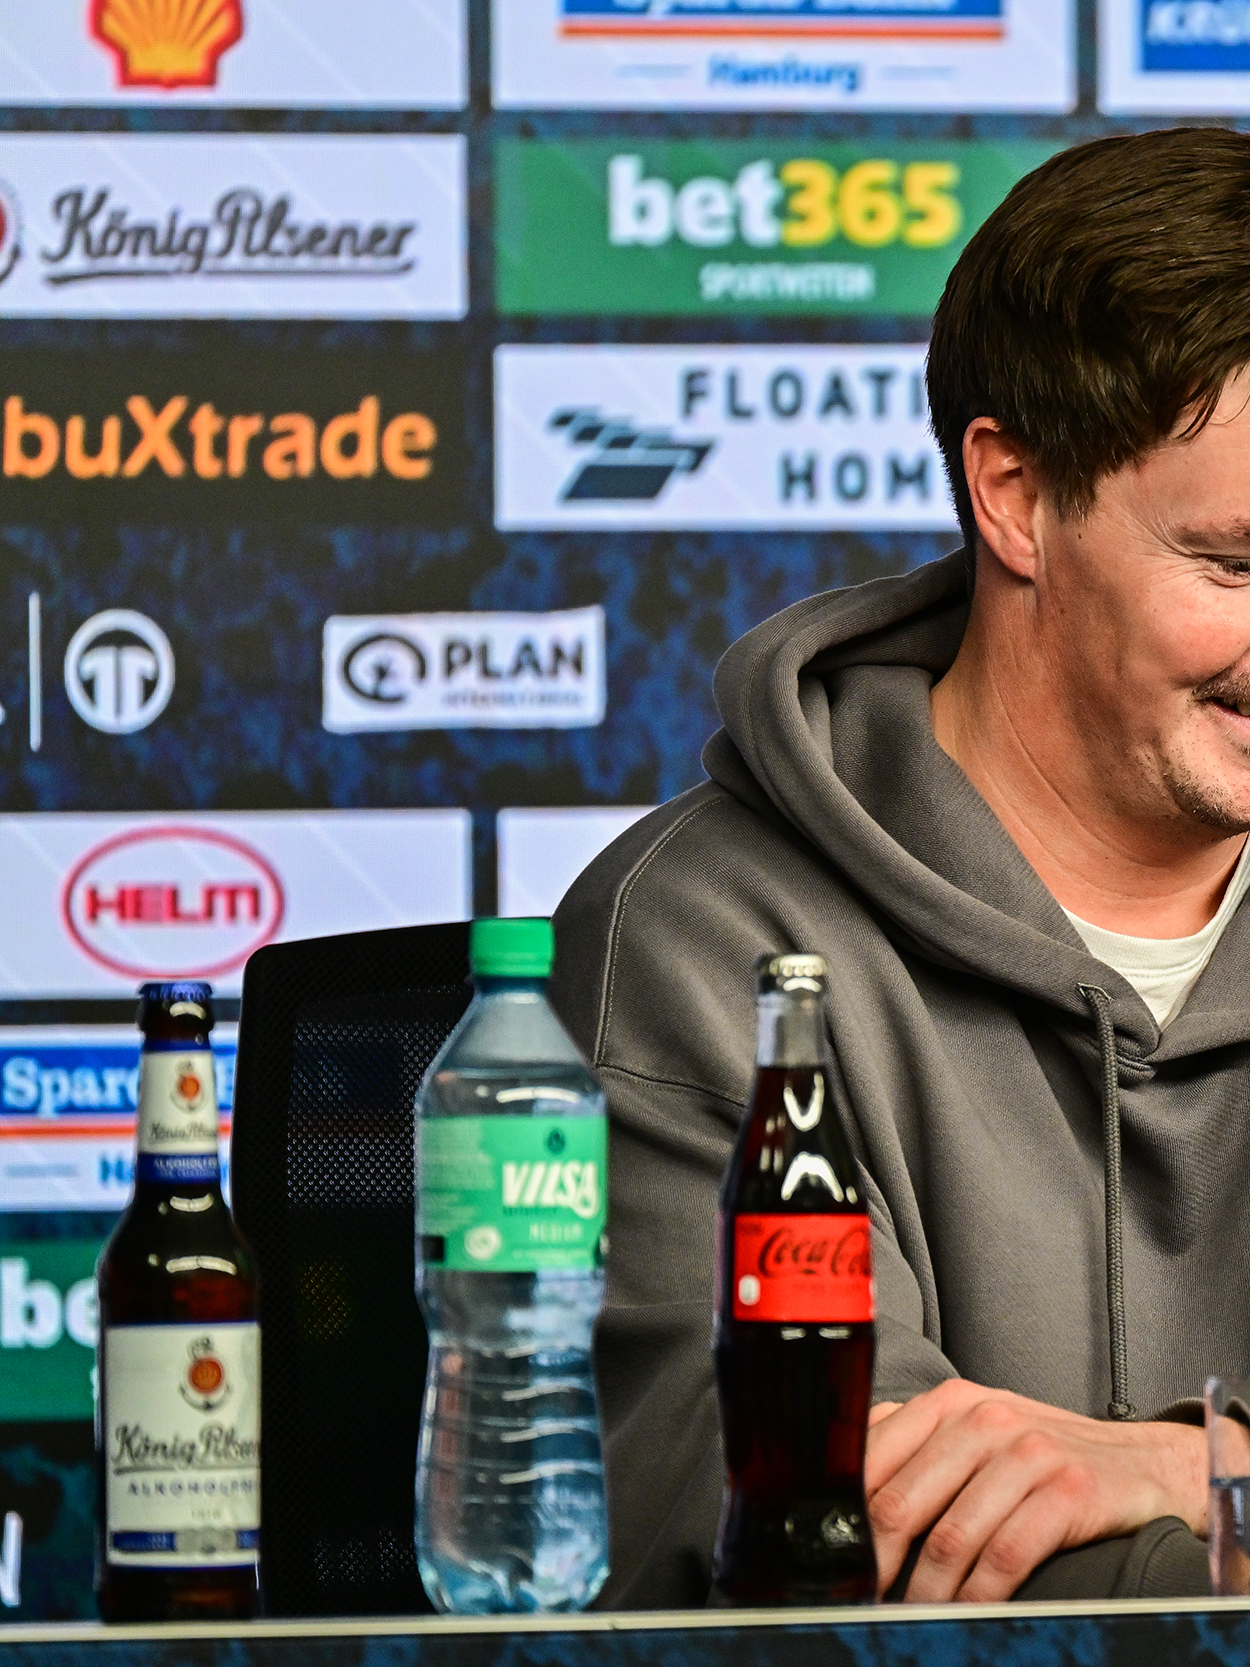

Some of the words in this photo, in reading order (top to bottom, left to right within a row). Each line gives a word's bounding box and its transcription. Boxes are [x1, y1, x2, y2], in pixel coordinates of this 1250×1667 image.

[42, 186, 209, 273] König
[212, 184, 418, 260] Pilsener
[608, 154, 964, 248] bet365
[681, 366, 929, 422] FLOATI
[2, 395, 438, 480] buXtrade
[779, 450, 937, 504] HOM
[444, 634, 586, 679] PLAN
[86, 883, 261, 924] HELM
[503, 1161, 600, 1219] VILSA
